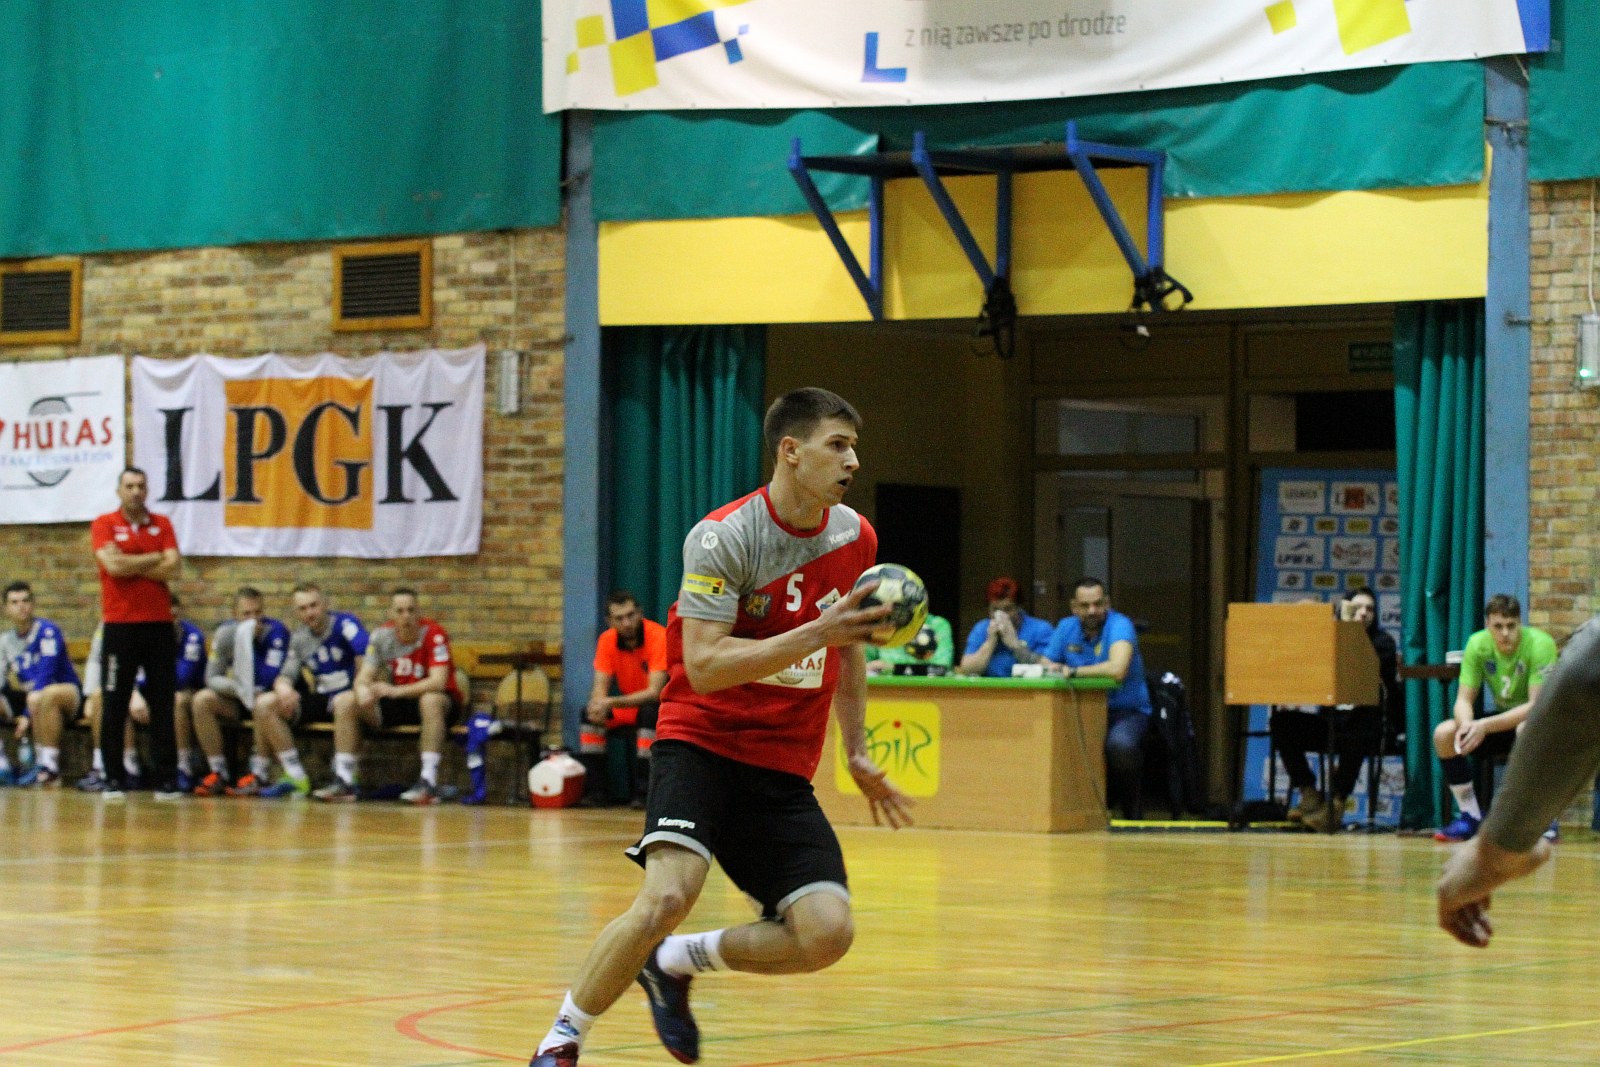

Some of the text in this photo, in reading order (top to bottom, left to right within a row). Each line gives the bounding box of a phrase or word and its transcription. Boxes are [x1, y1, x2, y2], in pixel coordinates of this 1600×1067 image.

[905, 10, 1127, 50] z nią zawsze po drodze
[157, 401, 459, 505] LPGK
[828, 527, 856, 545] Kempa
[785, 573, 804, 612] 5
[657, 816, 697, 830] Kempa
